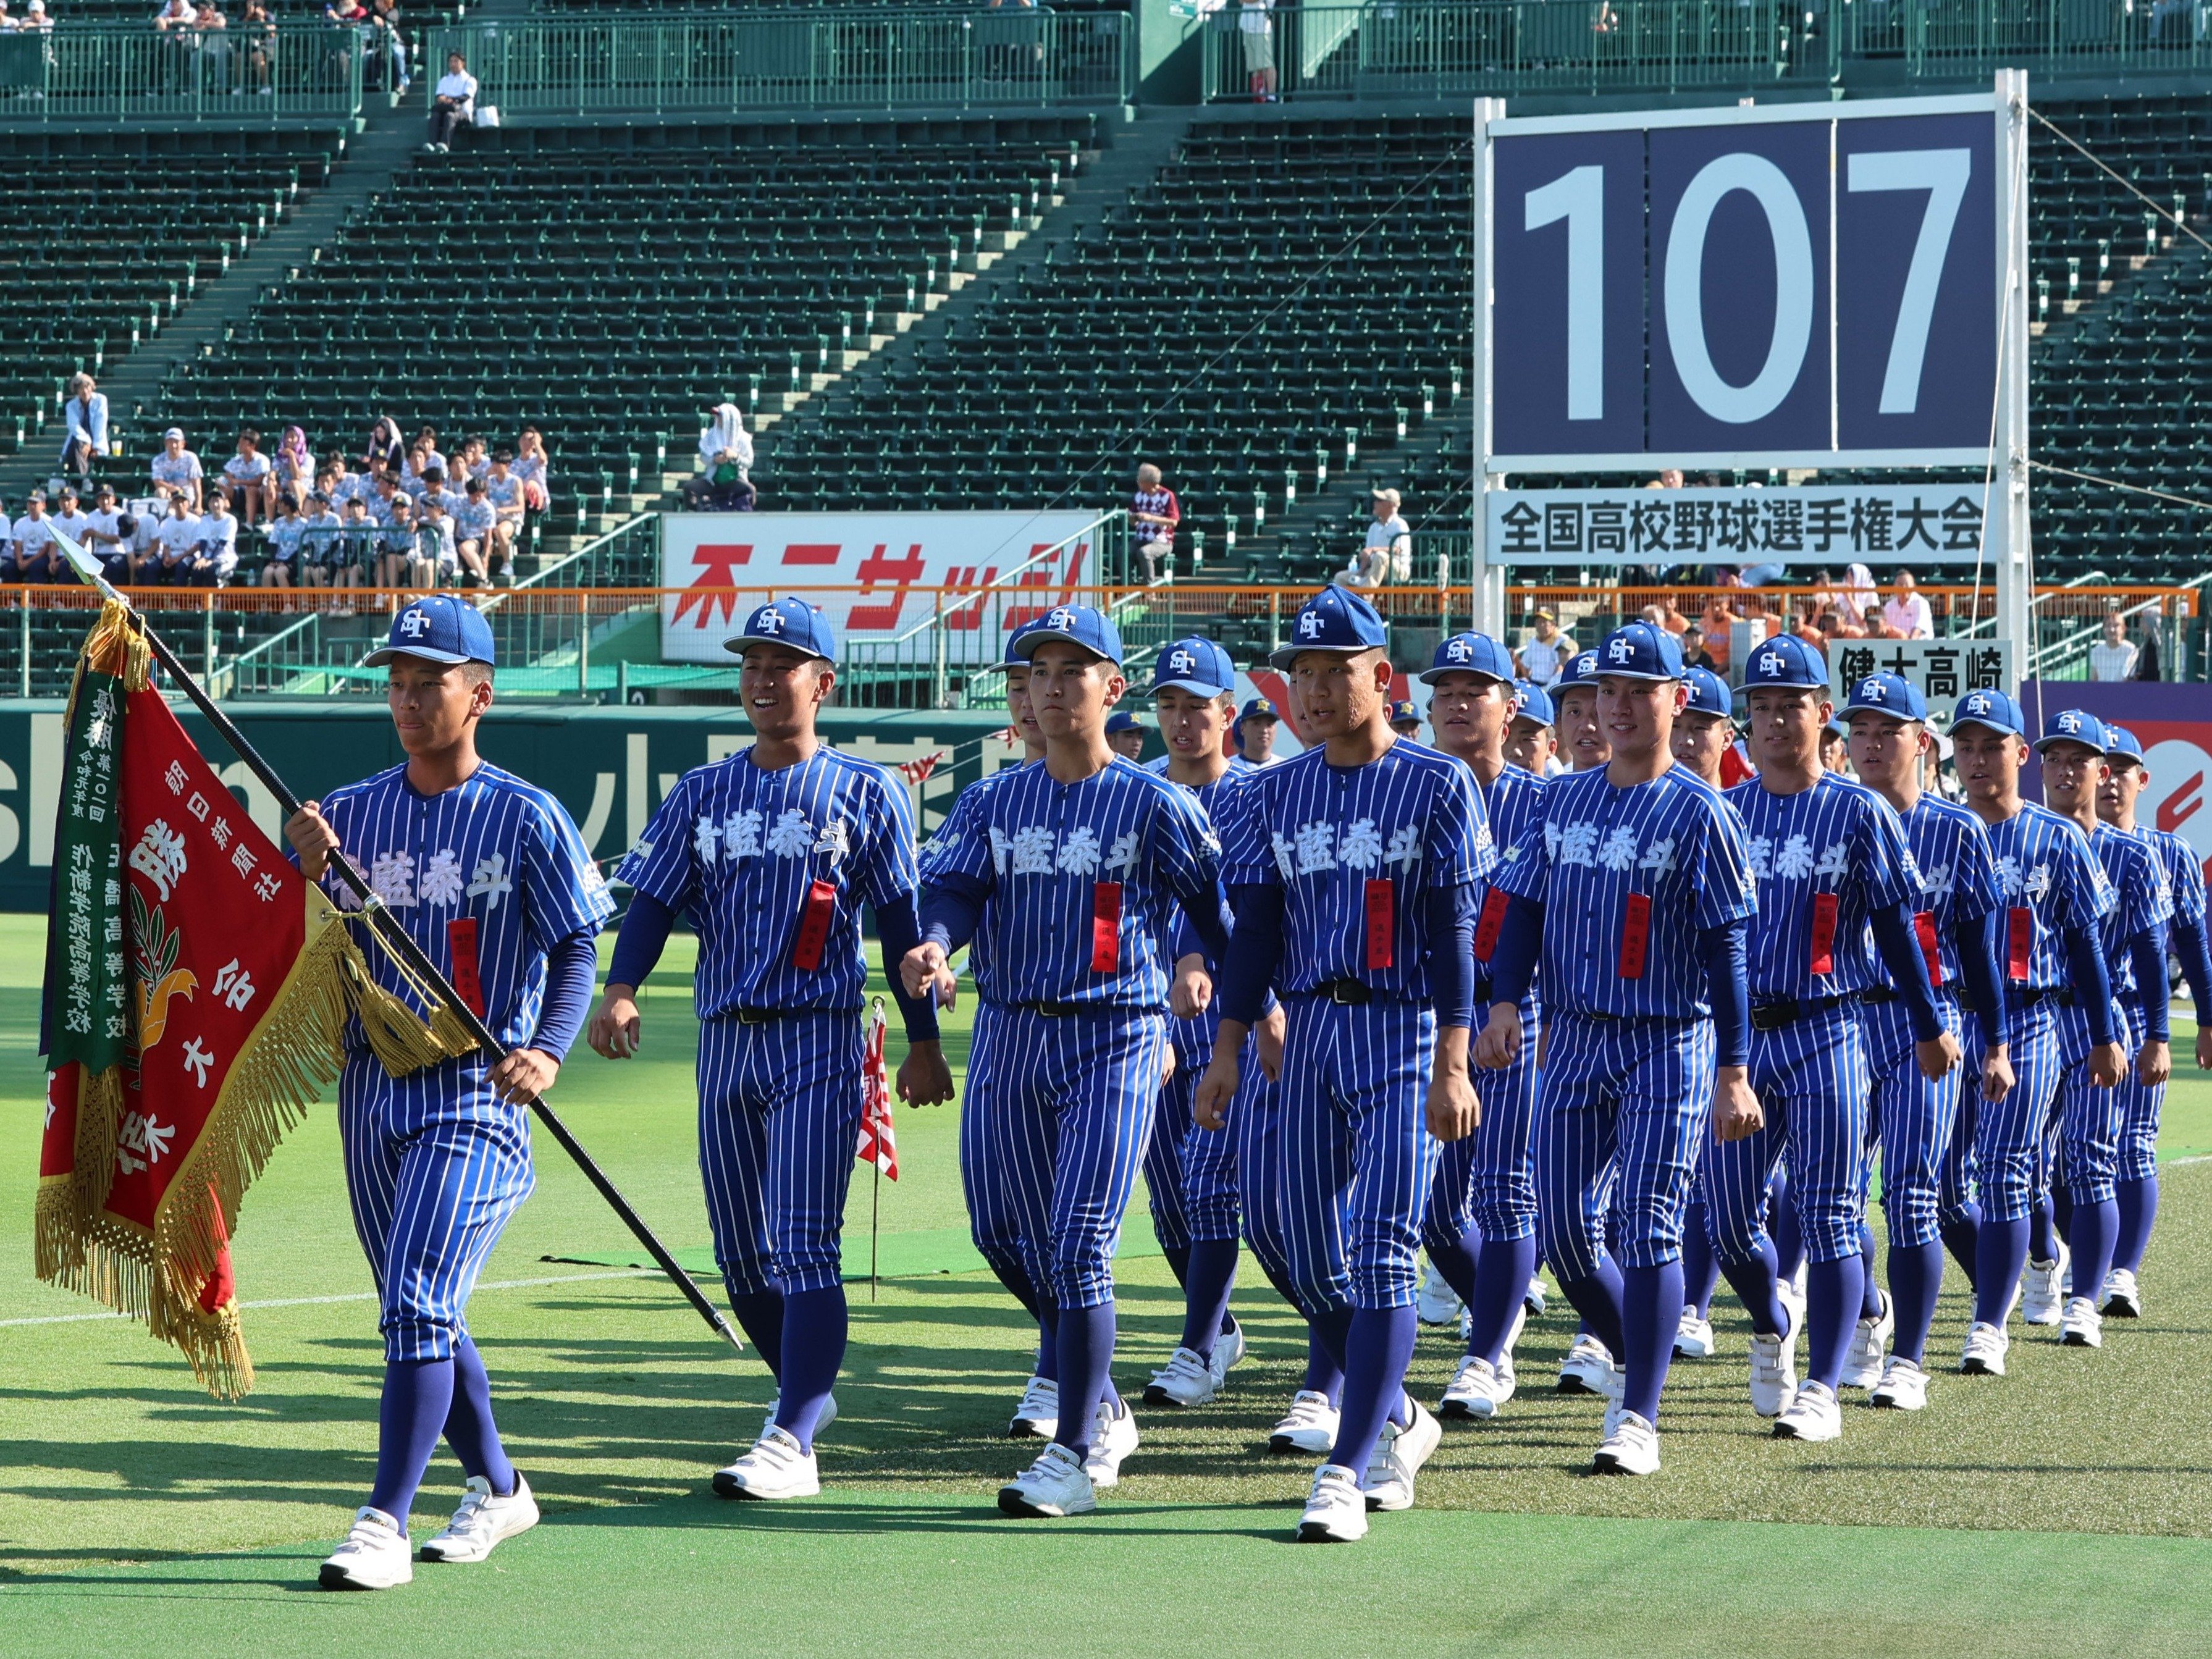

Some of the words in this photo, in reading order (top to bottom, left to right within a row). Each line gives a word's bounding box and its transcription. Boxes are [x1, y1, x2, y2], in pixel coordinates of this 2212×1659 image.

[1525, 148, 1971, 423] 107
[1500, 496, 1984, 555] 全国高校野球選手権大会
[1839, 647, 2002, 698] 健大高崎
[128, 818, 187, 902] 勝
[164, 760, 282, 902] 朝日新聞社
[694, 808, 850, 866] 青藍泰斗
[1271, 818, 1423, 875] 青藍泰斗
